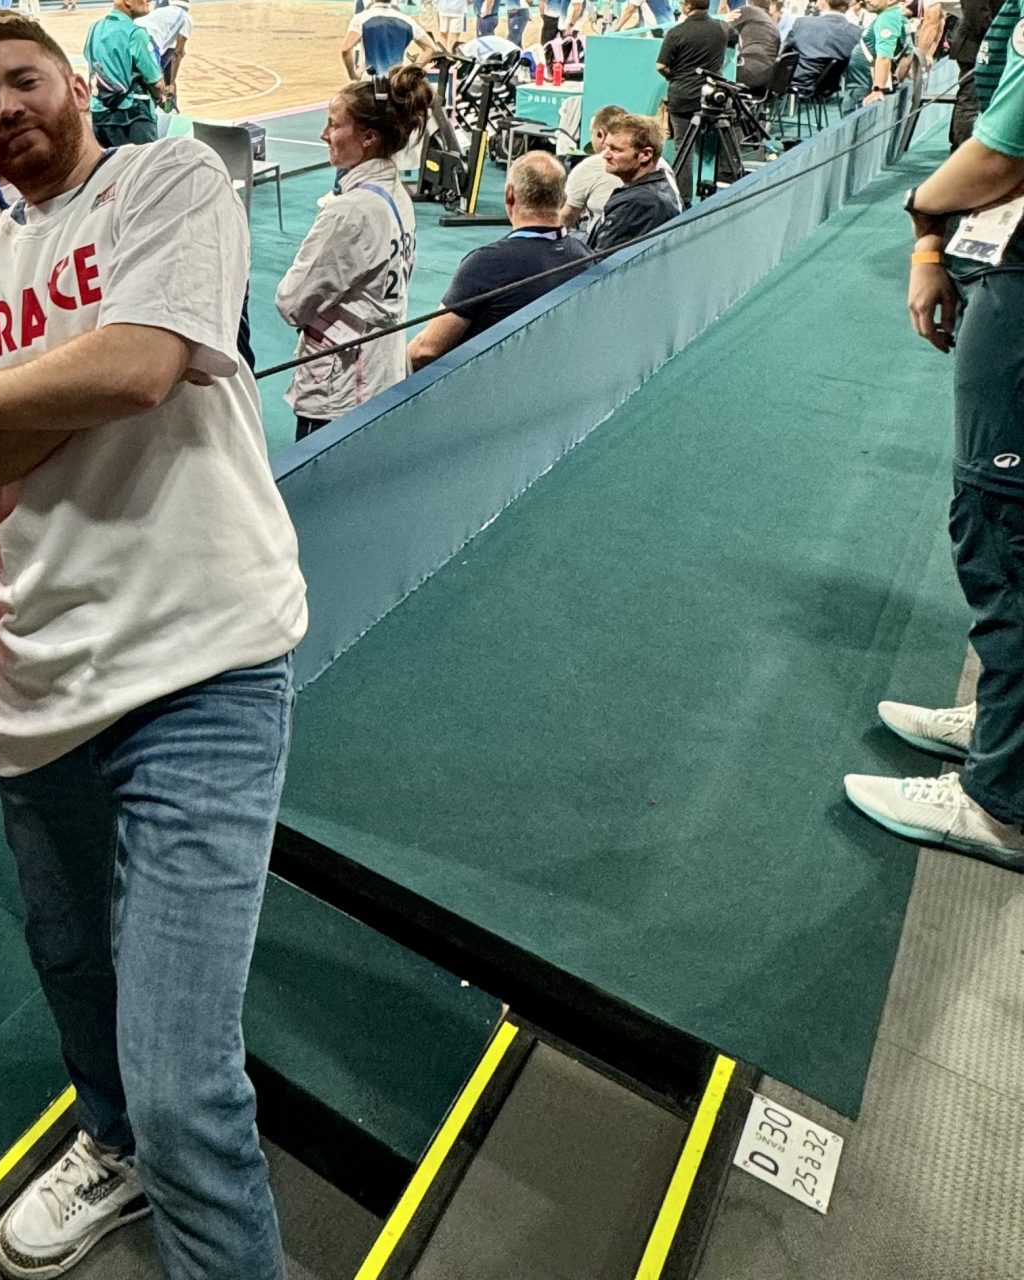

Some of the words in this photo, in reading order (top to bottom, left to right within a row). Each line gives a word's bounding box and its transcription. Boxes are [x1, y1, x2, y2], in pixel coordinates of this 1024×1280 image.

[758, 1107, 792, 1144] 30
[755, 1132, 786, 1153] RANG
[803, 1129, 829, 1158] 32
[748, 1150, 779, 1177] D
[792, 1167, 818, 1197] 25
